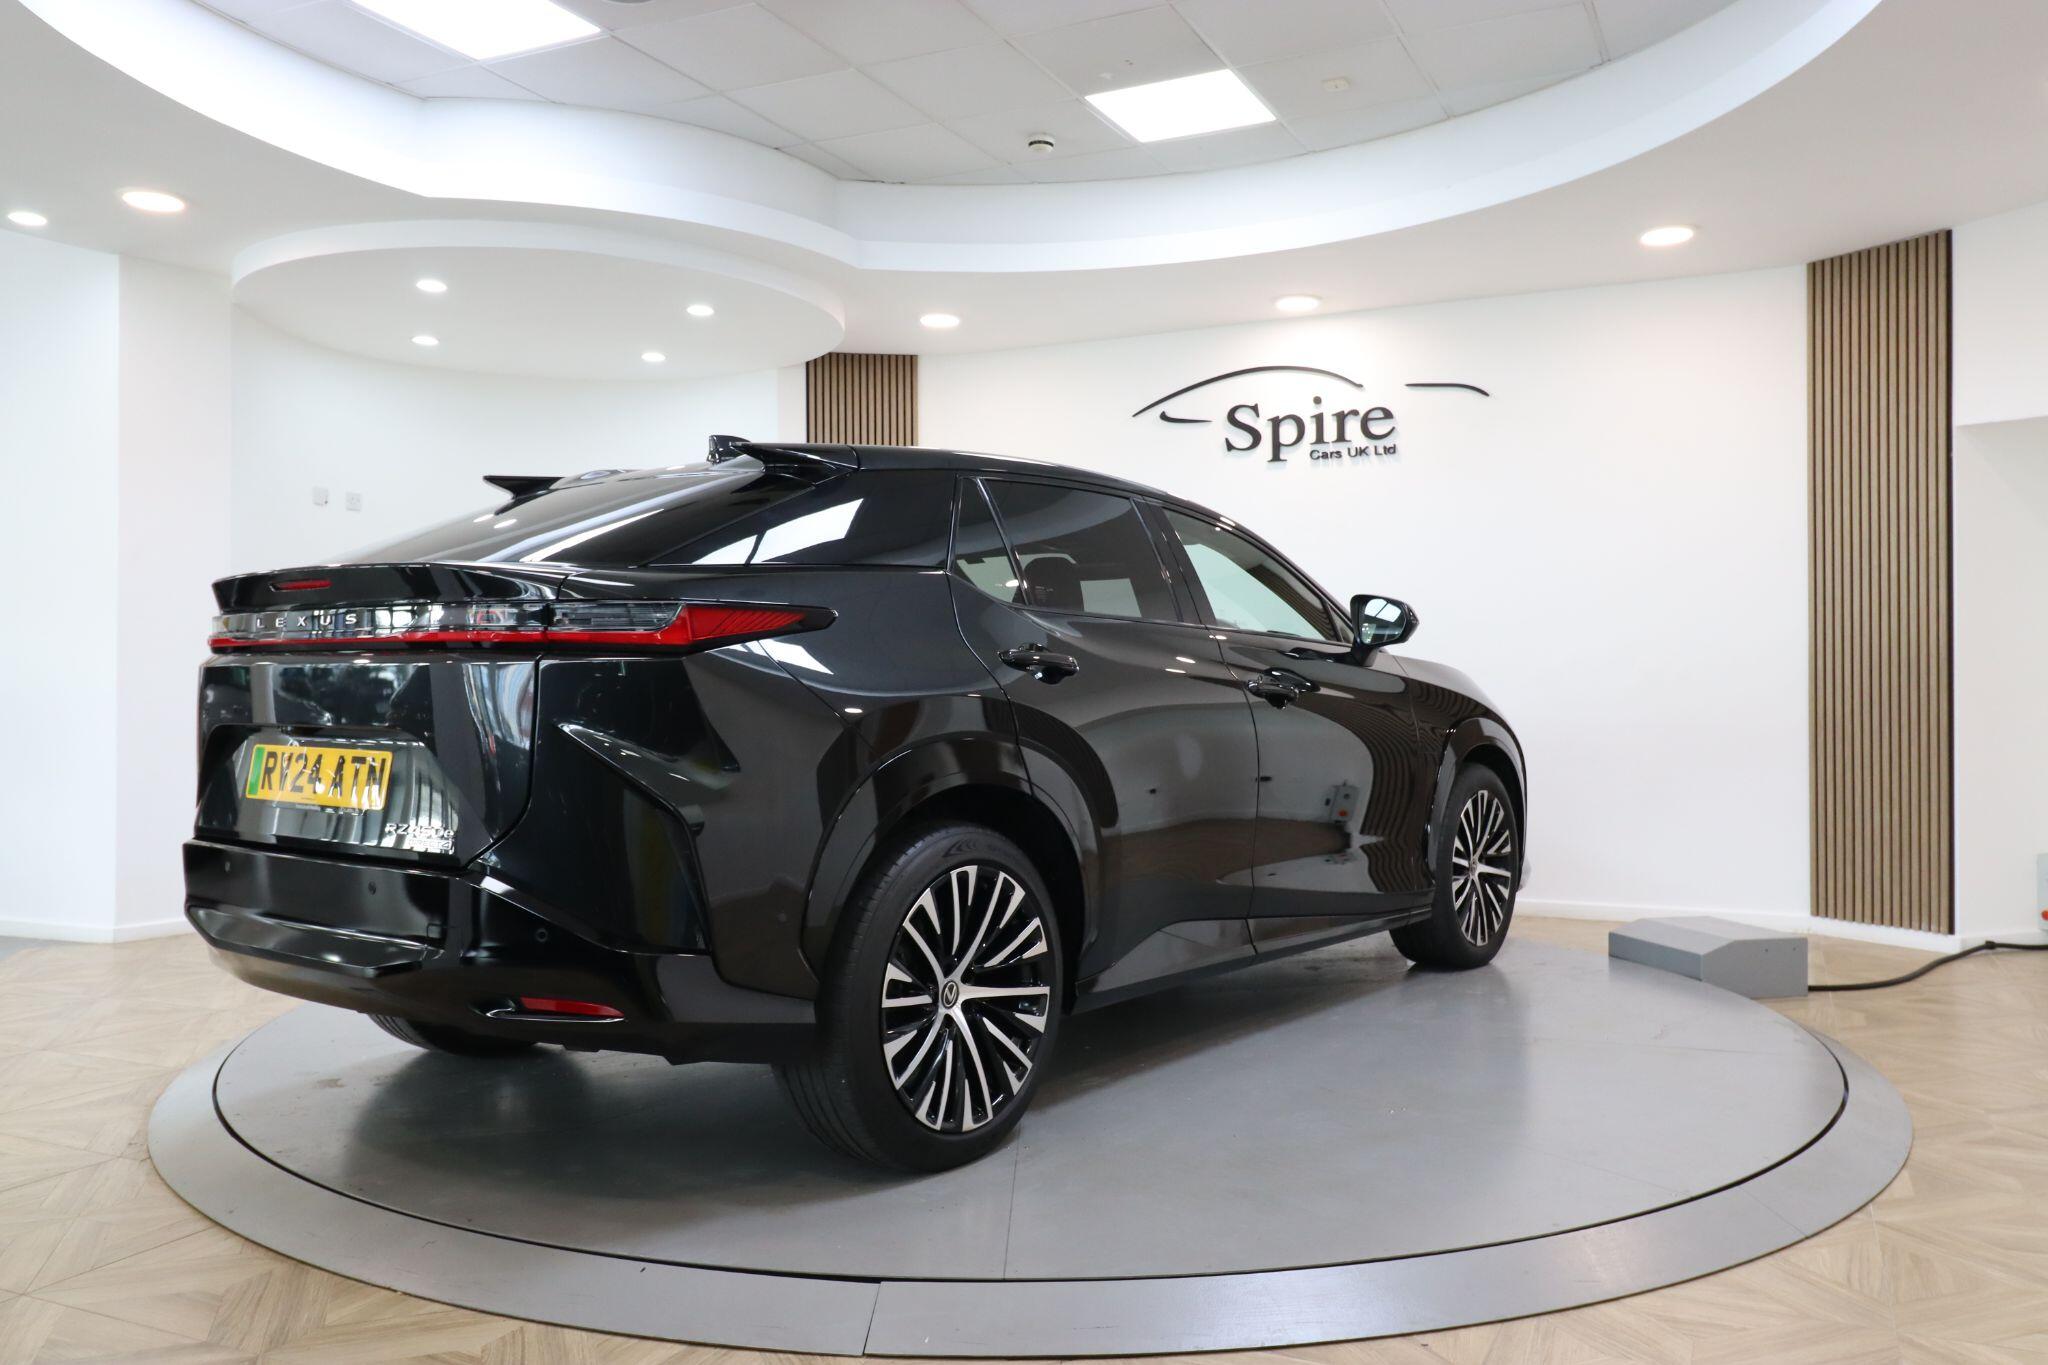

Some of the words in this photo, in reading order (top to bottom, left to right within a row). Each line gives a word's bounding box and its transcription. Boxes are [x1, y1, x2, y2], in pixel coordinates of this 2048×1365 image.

[1225, 396, 1396, 462] Spire
[1310, 449, 1342, 460] Cars
[1347, 446, 1369, 457] UK
[1374, 444, 1396, 455] Ltd
[256, 613, 357, 628] LEXUS
[260, 751, 323, 794] RV24
[327, 755, 387, 804] ATN
